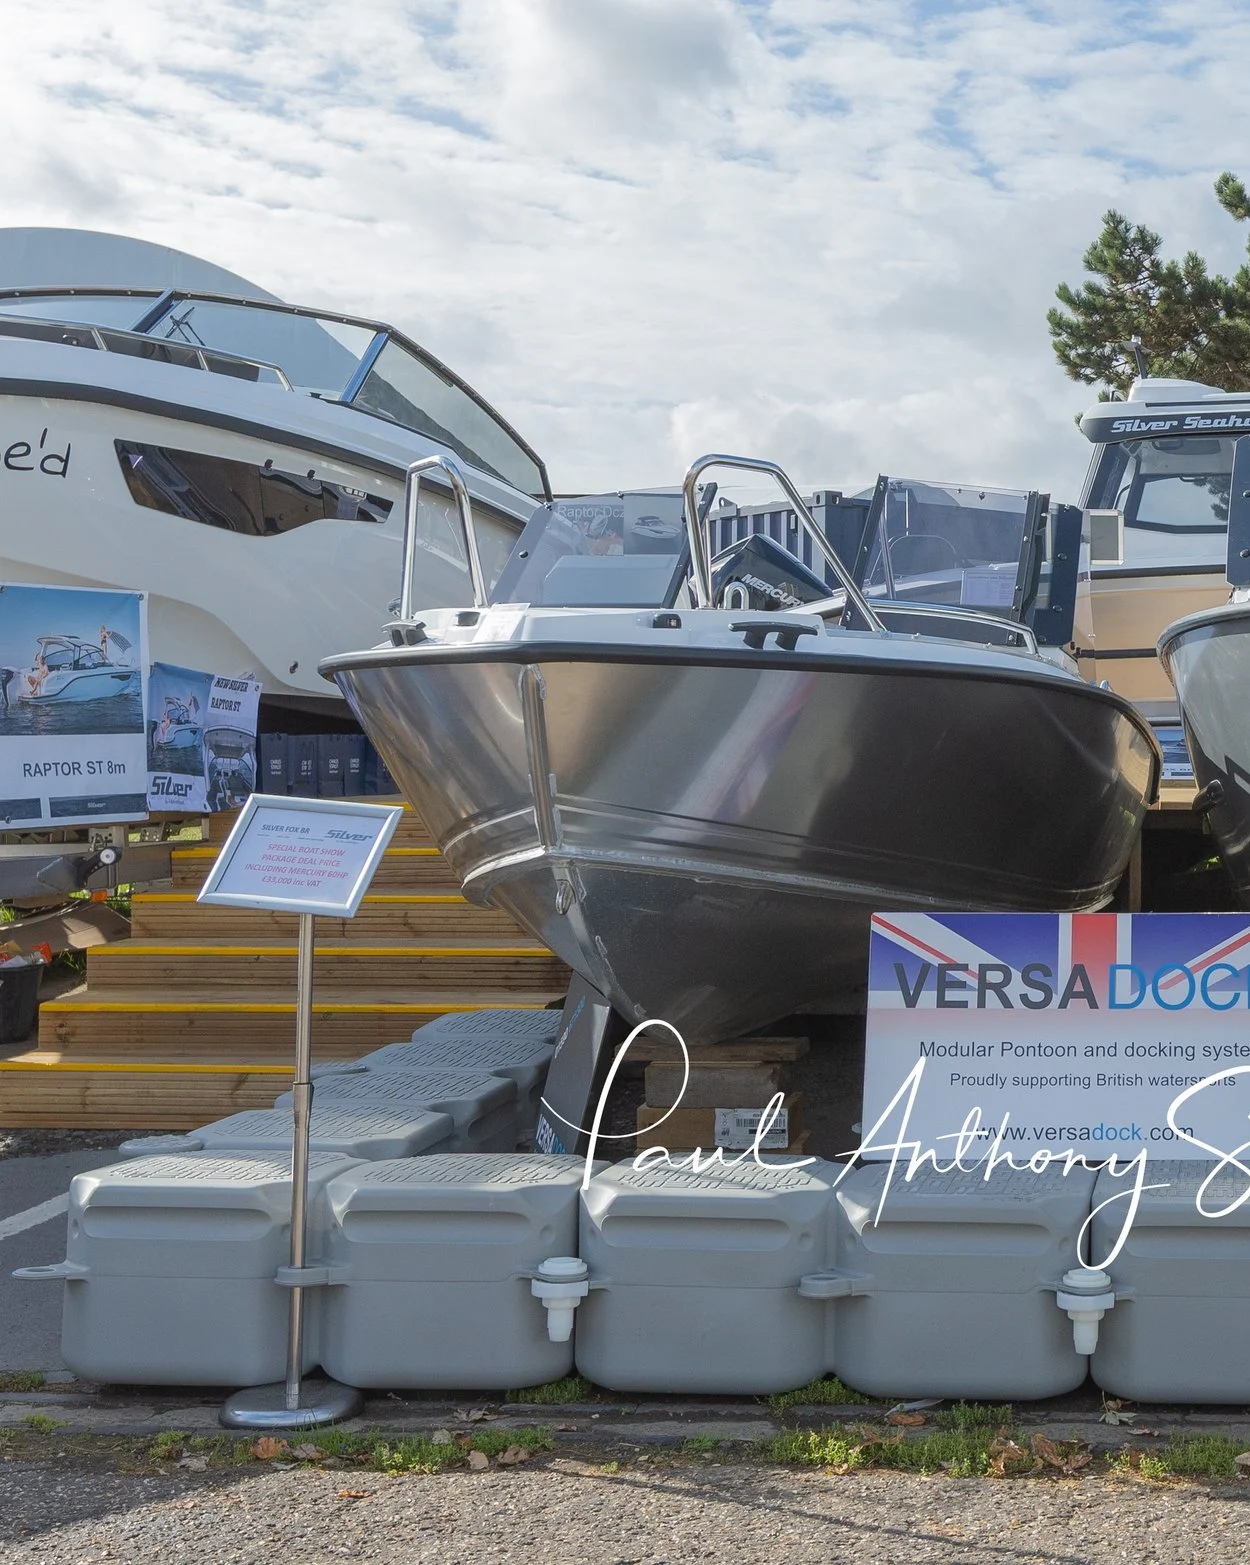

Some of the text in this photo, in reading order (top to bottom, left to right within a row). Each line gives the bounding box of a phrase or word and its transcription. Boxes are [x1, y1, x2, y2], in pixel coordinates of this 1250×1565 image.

[1111, 419, 1178, 433] Silver
[0, 427, 71, 478] e'd
[741, 573, 805, 608] MERCUR
[214, 677, 231, 689] NEW
[210, 697, 241, 712] RAPTOR ST
[23, 760, 126, 777] RAPTOR ST 8m
[151, 776, 192, 797] Silver
[262, 824, 285, 833] SILVER
[285, 825, 300, 833] FOX
[324, 829, 373, 841] Silver
[267, 844, 346, 857] SPECIAL BOAT SHOW
[261, 853, 342, 867] PACKAGE DEAL PRICE
[244, 863, 349, 879] INCLUDING MERCURY 60HP
[306, 879, 322, 888] VAT
[919, 1040, 995, 1058] Modular
[1000, 1041, 1078, 1058] Pontoon
[1083, 1040, 1119, 1058] and
[1124, 1040, 1196, 1062] docking
[949, 1072, 1008, 1089] Proudly
[1012, 1073, 1092, 1090] supporting
[1096, 1072, 1144, 1087] British
